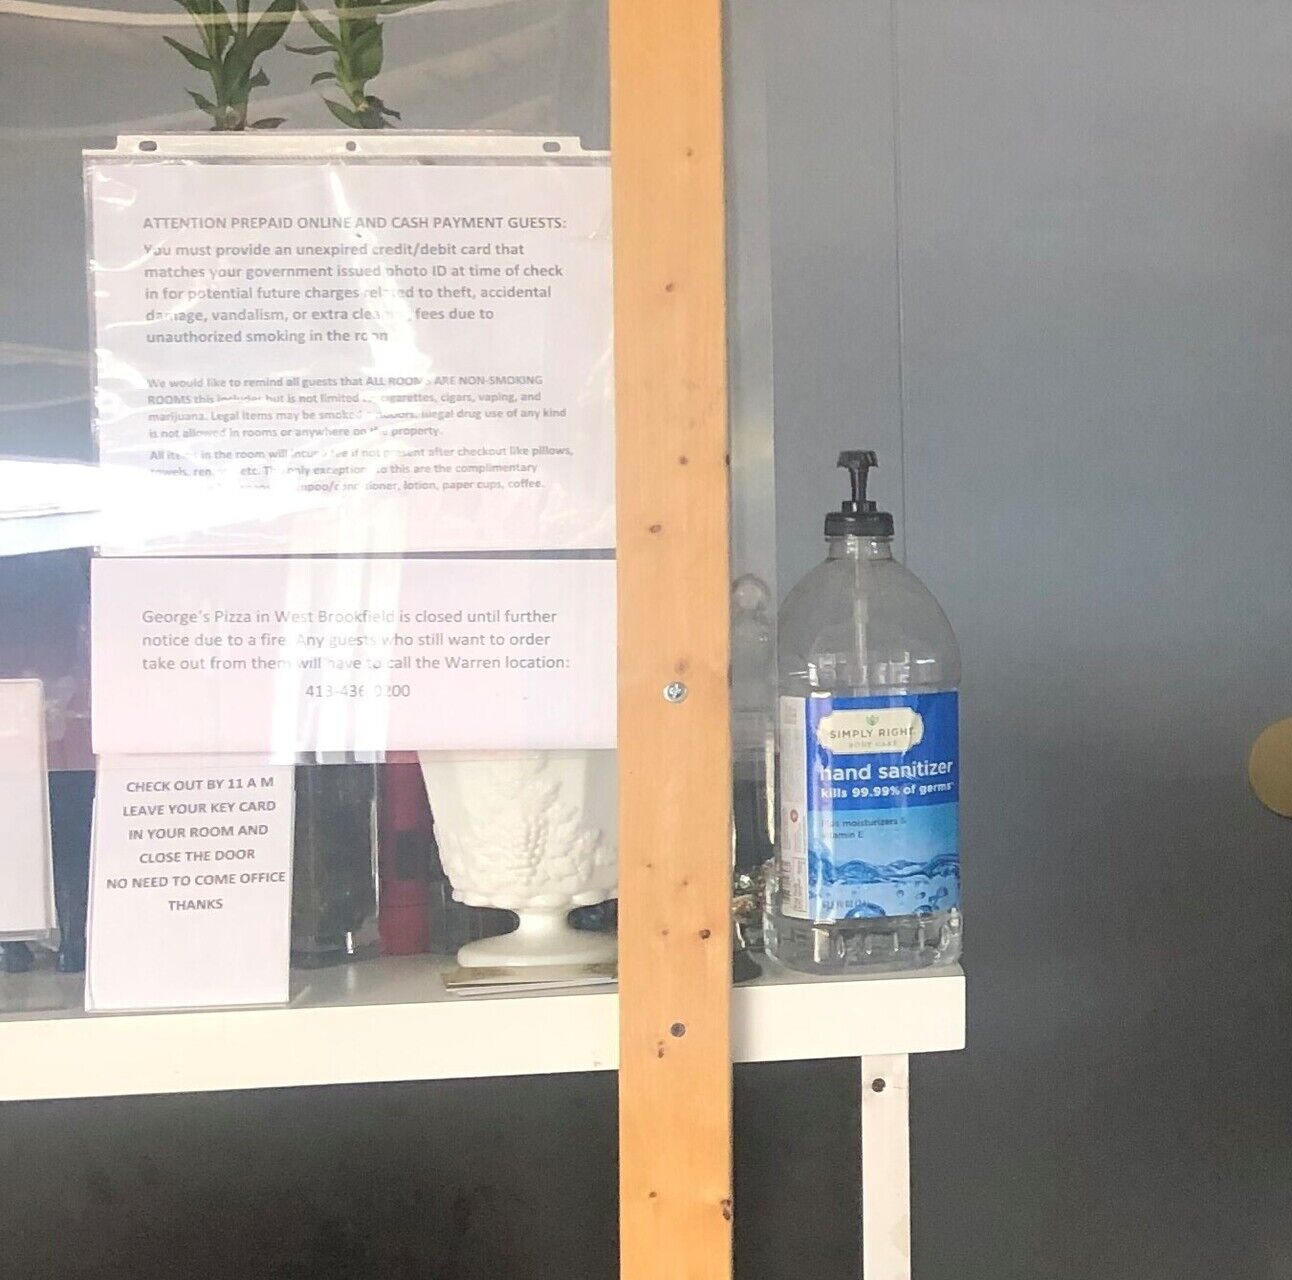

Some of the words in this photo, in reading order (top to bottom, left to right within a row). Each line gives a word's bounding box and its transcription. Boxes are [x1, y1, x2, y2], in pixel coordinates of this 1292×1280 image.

[143, 217, 226, 229] ATTENTION
[231, 217, 292, 229] PREPAID
[297, 217, 352, 229] ONLINE
[355, 217, 387, 229] AND
[391, 217, 429, 229] CASH
[433, 217, 503, 228] PAYMENT
[508, 216, 567, 228] GUESTS:
[175, 246, 211, 256] must
[216, 244, 270, 258] provide
[274, 246, 292, 256] an
[296, 244, 368, 258] unexpired
[372, 243, 457, 257] credit/debit
[461, 243, 491, 255] card
[495, 243, 524, 255] that
[144, 266, 205, 278] matches
[209, 268, 242, 280] your
[246, 266, 333, 280] government
[337, 265, 381, 277] issued
[431, 265, 447, 276] ID
[451, 267, 465, 276] at
[469, 265, 501, 276] time
[505, 264, 520, 276] of
[523, 264, 563, 276] check
[146, 288, 158, 299] in
[163, 288, 183, 299] for
[188, 287, 252, 301] potential
[257, 287, 300, 298] future
[304, 287, 359, 301] charges
[418, 288, 432, 298] to
[437, 286, 476, 299] theft,
[480, 286, 551, 297] accidental
[212, 309, 288, 322] vandalism,
[292, 310, 306, 319] or
[312, 310, 348, 319] extra
[415, 308, 445, 319] fees
[449, 308, 475, 319] due
[480, 309, 494, 319] to
[147, 331, 242, 343] unauthorized
[246, 330, 305, 345] smoking
[310, 330, 323, 341] in
[327, 330, 351, 341] the
[169, 378, 203, 388] would
[206, 377, 226, 388] like
[229, 379, 241, 387] to
[243, 377, 283, 387] remind
[286, 377, 300, 387] all
[302, 377, 338, 388] guests
[341, 376, 363, 386] that
[365, 376, 386, 386] ALL
[434, 376, 455, 385] ARE
[299, 394, 318, 403] not
[521, 392, 542, 402] and
[276, 412, 299, 422] may
[457, 409, 482, 420] drug
[485, 410, 503, 418] use
[506, 408, 518, 418] of
[520, 410, 540, 420] any
[543, 408, 566, 418] kind
[242, 428, 277, 437] rooms
[280, 428, 292, 436] or
[214, 449, 232, 459] the
[235, 450, 265, 459] room
[429, 447, 454, 456] after
[457, 447, 506, 456] checkout
[510, 446, 529, 456] like
[390, 464, 410, 474] this
[413, 465, 431, 473] are
[434, 464, 452, 473] the
[443, 480, 474, 491] paper
[142, 610, 210, 625] George's
[215, 610, 252, 623] Pizza
[256, 610, 270, 622] in
[275, 610, 313, 623] West
[319, 609, 394, 622] Brookfield
[399, 610, 410, 622] is
[415, 609, 462, 622] closed
[468, 609, 501, 622] until
[505, 609, 557, 622] further
[142, 633, 189, 646] notice
[194, 633, 223, 646] due
[227, 635, 243, 646] to
[248, 636, 256, 646] a
[296, 634, 324, 648] Any
[329, 634, 376, 648] guests
[382, 632, 413, 645] who
[418, 632, 444, 645] still
[448, 634, 486, 645] want
[490, 634, 505, 645] to
[509, 632, 551, 645] order
[142, 656, 175, 669] take
[180, 658, 205, 669] out
[210, 656, 247, 669] from
[251, 656, 292, 669] them
[297, 656, 321, 669] will
[388, 656, 411, 669] call
[415, 656, 440, 668] the
[445, 656, 501, 668] Warren
[505, 656, 570, 668] location:
[830, 729, 873, 739] SIMPLY
[820, 763, 872, 781] hand
[878, 760, 953, 780] sanitizer
[126, 781, 170, 793] CHECK
[174, 779, 203, 791] OUT
[207, 778, 225, 790] BY
[229, 778, 242, 789] 11
[247, 777, 257, 788] A
[260, 776, 274, 787] M
[821, 787, 848, 799] kills
[852, 785, 900, 798] 99.99%
[903, 784, 916, 795] of
[123, 804, 164, 817] LEAVE
[169, 803, 207, 815] YOUR
[211, 802, 235, 813] KEY
[239, 800, 276, 812] CARD
[129, 830, 143, 840] IN
[147, 828, 186, 839] YOUR
[190, 826, 234, 838] ROOM
[238, 824, 268, 836] AND
[140, 852, 181, 864] CLOSE
[185, 850, 211, 862] THE
[215, 849, 255, 861] DOOR
[107, 878, 127, 889] NO
[132, 877, 168, 888] NEED
[172, 875, 190, 887] TO
[195, 874, 236, 886] COME
[240, 872, 286, 884] OFFICE
[168, 899, 223, 911] THANKS
